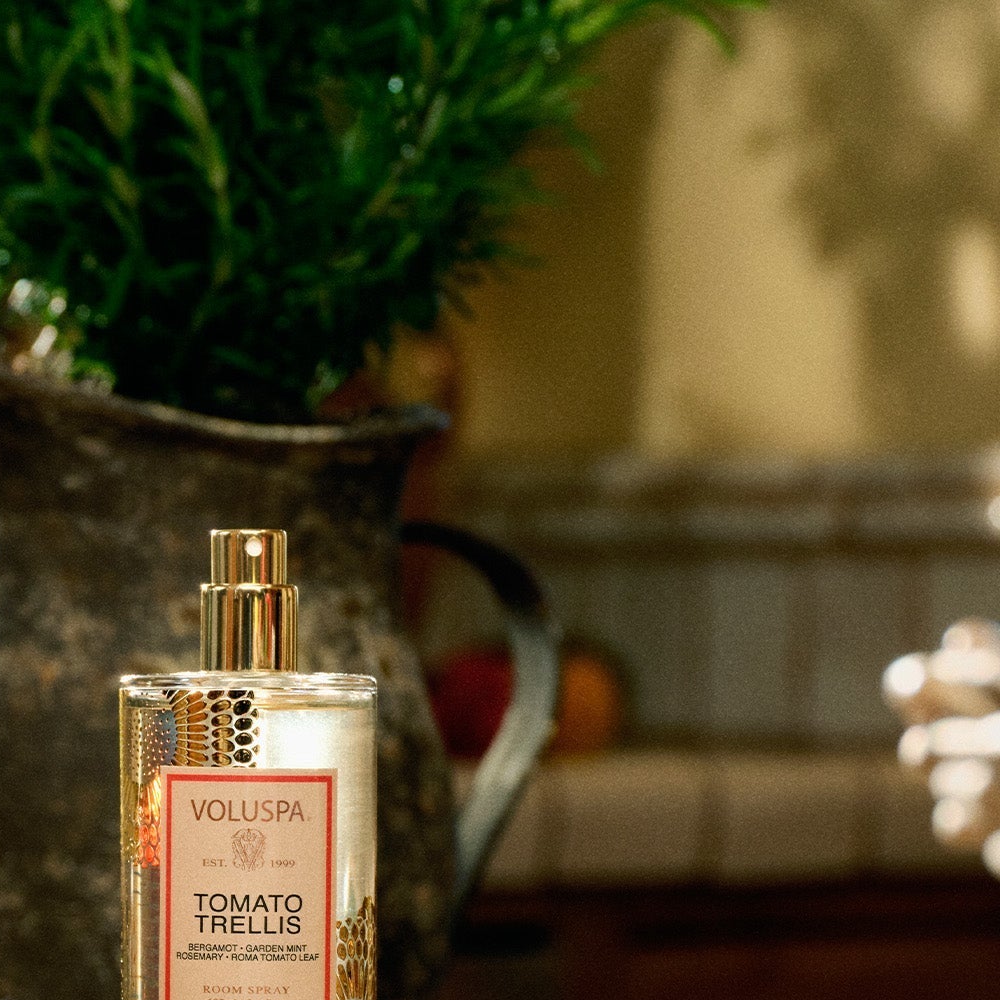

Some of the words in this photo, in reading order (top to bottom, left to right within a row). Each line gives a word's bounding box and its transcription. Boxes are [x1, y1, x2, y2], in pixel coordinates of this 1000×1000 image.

[191, 799, 305, 822] VOLUSPA
[271, 859, 296, 868] 1999
[194, 893, 303, 913] TOMATO
[194, 915, 301, 934] TRELLIS
[188, 943, 238, 952] BERGAMOT
[245, 944, 284, 953] GARDEN
[286, 945, 307, 953] MINT
[176, 952, 224, 961] ROSEMARY
[231, 953, 259, 962] ROMA
[261, 954, 297, 962] TOMATO
[299, 954, 320, 962] LEAF
[203, 985, 242, 995] ROOM
[247, 985, 290, 995] SPRAY
